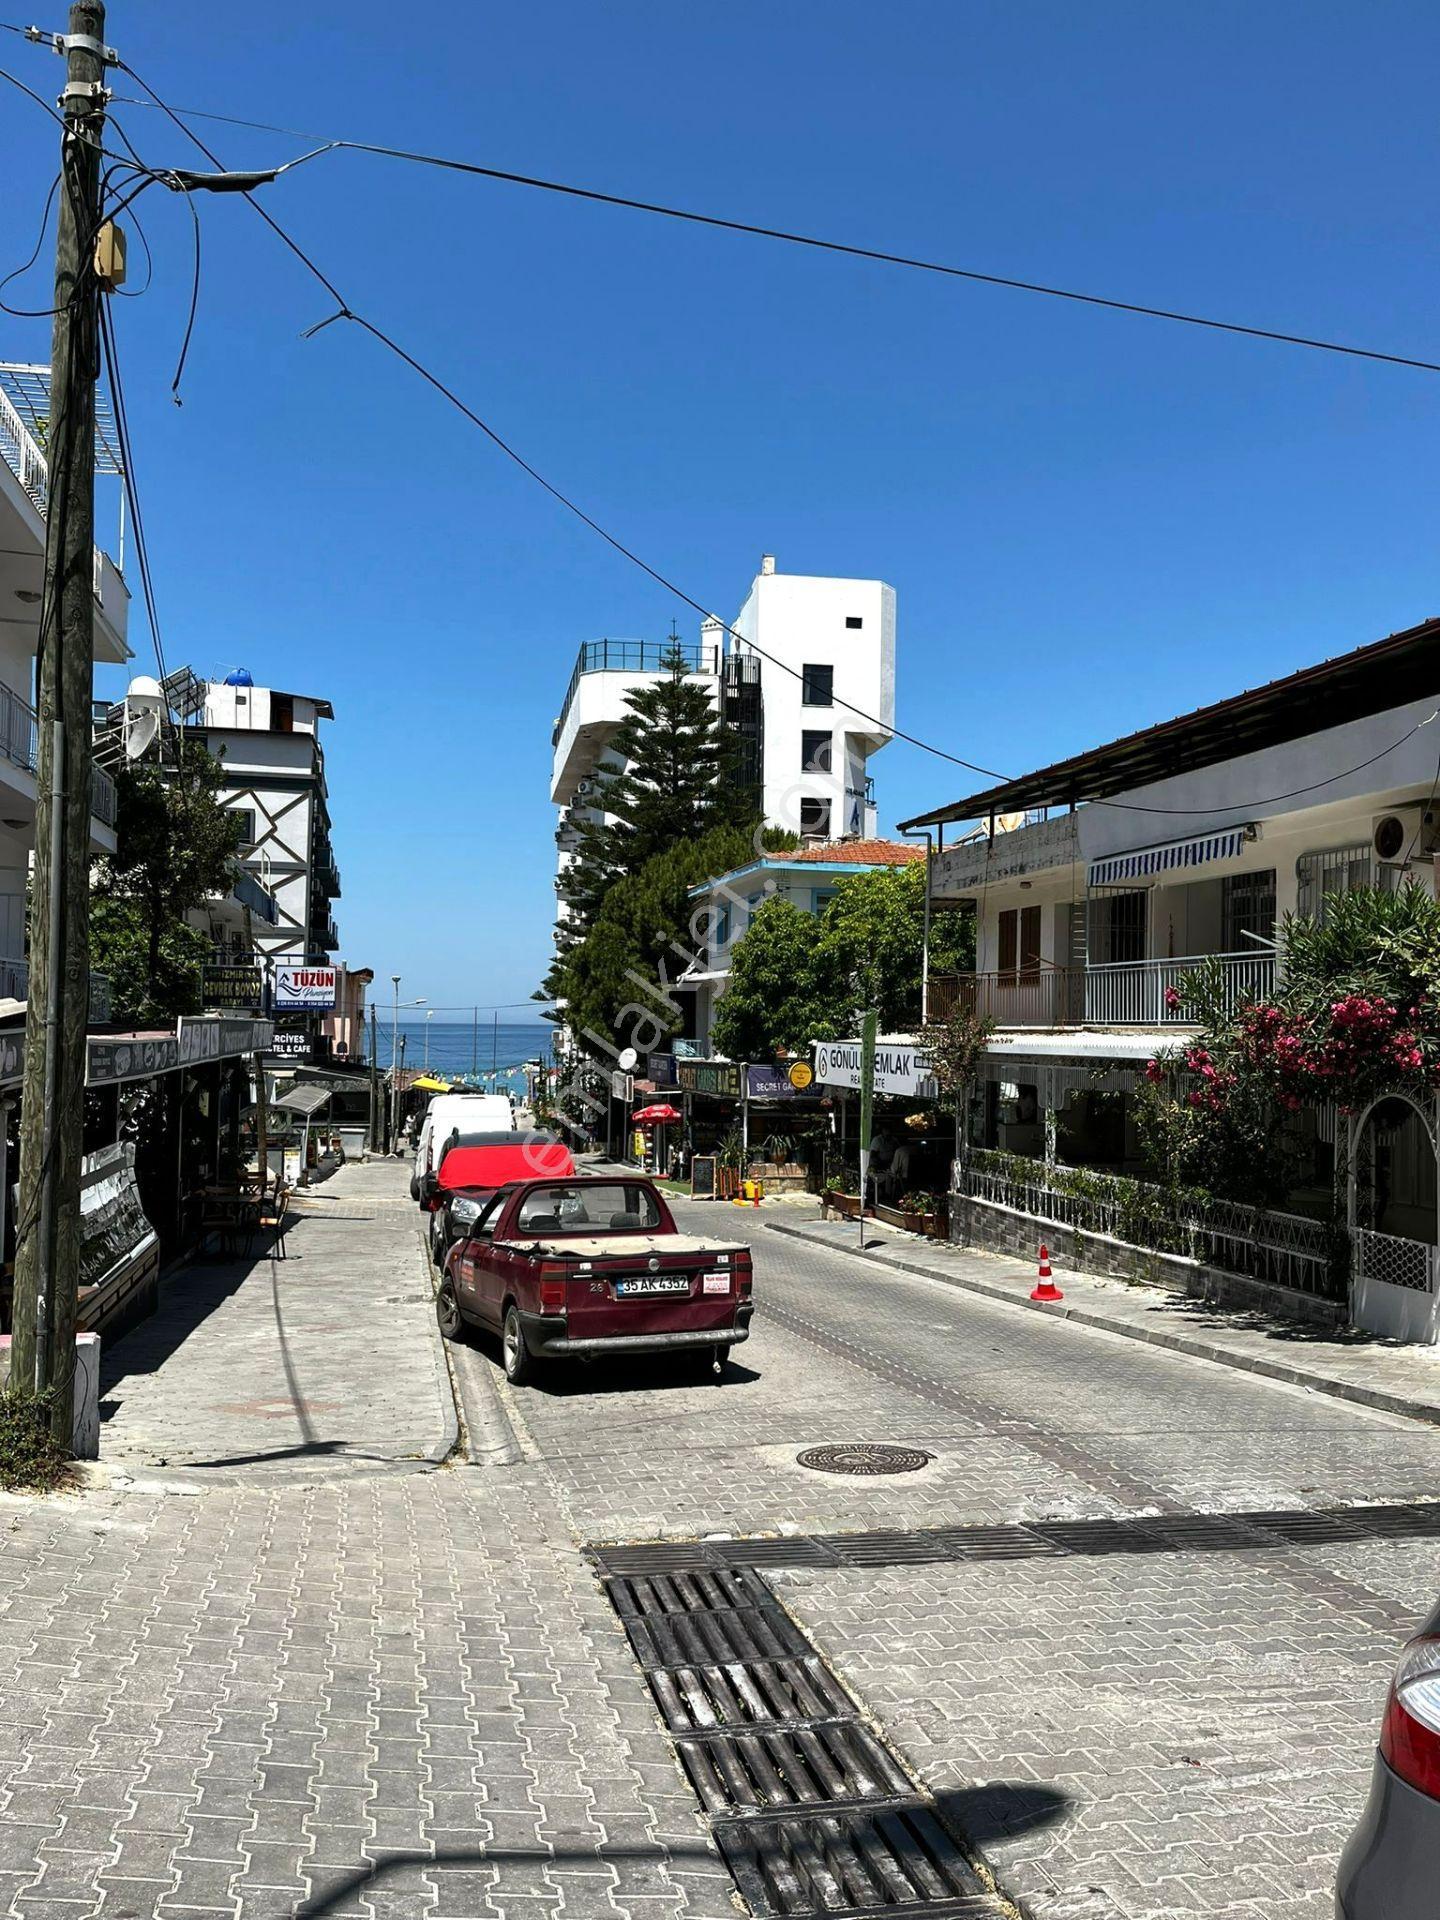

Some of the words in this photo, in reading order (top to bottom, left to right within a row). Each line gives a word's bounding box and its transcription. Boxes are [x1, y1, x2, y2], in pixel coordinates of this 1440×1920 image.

[292, 969, 334, 987] TÜZÜN
[286, 1044, 292, 1053] &
[293, 1044, 311, 1053] CAFE
[830, 1045, 863, 1071] GÖNÜL
[874, 1053, 911, 1076] EMLAK
[623, 1278, 639, 1292] 35
[640, 1277, 658, 1291] AK
[659, 1276, 687, 1290] 4352
